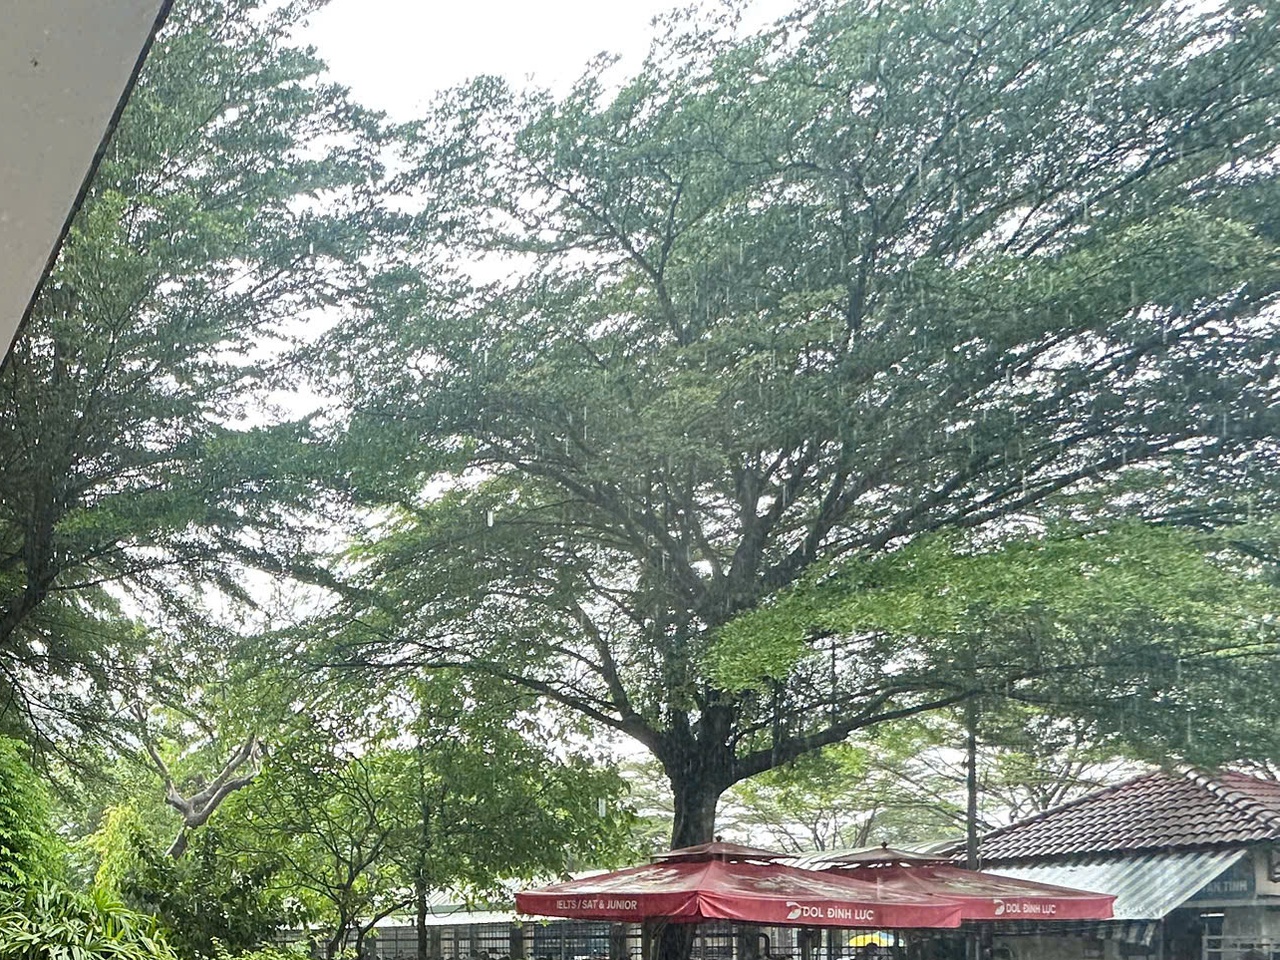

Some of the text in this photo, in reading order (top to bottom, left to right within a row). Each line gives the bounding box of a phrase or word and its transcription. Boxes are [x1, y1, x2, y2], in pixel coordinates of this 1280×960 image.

[556, 899, 577, 909] IELTS
[581, 899, 599, 909] SAT
[598, 900, 605, 909] &
[606, 900, 637, 910] JUNIOR
[1006, 903, 1021, 913] DOL
[801, 906, 824, 918] DOL
